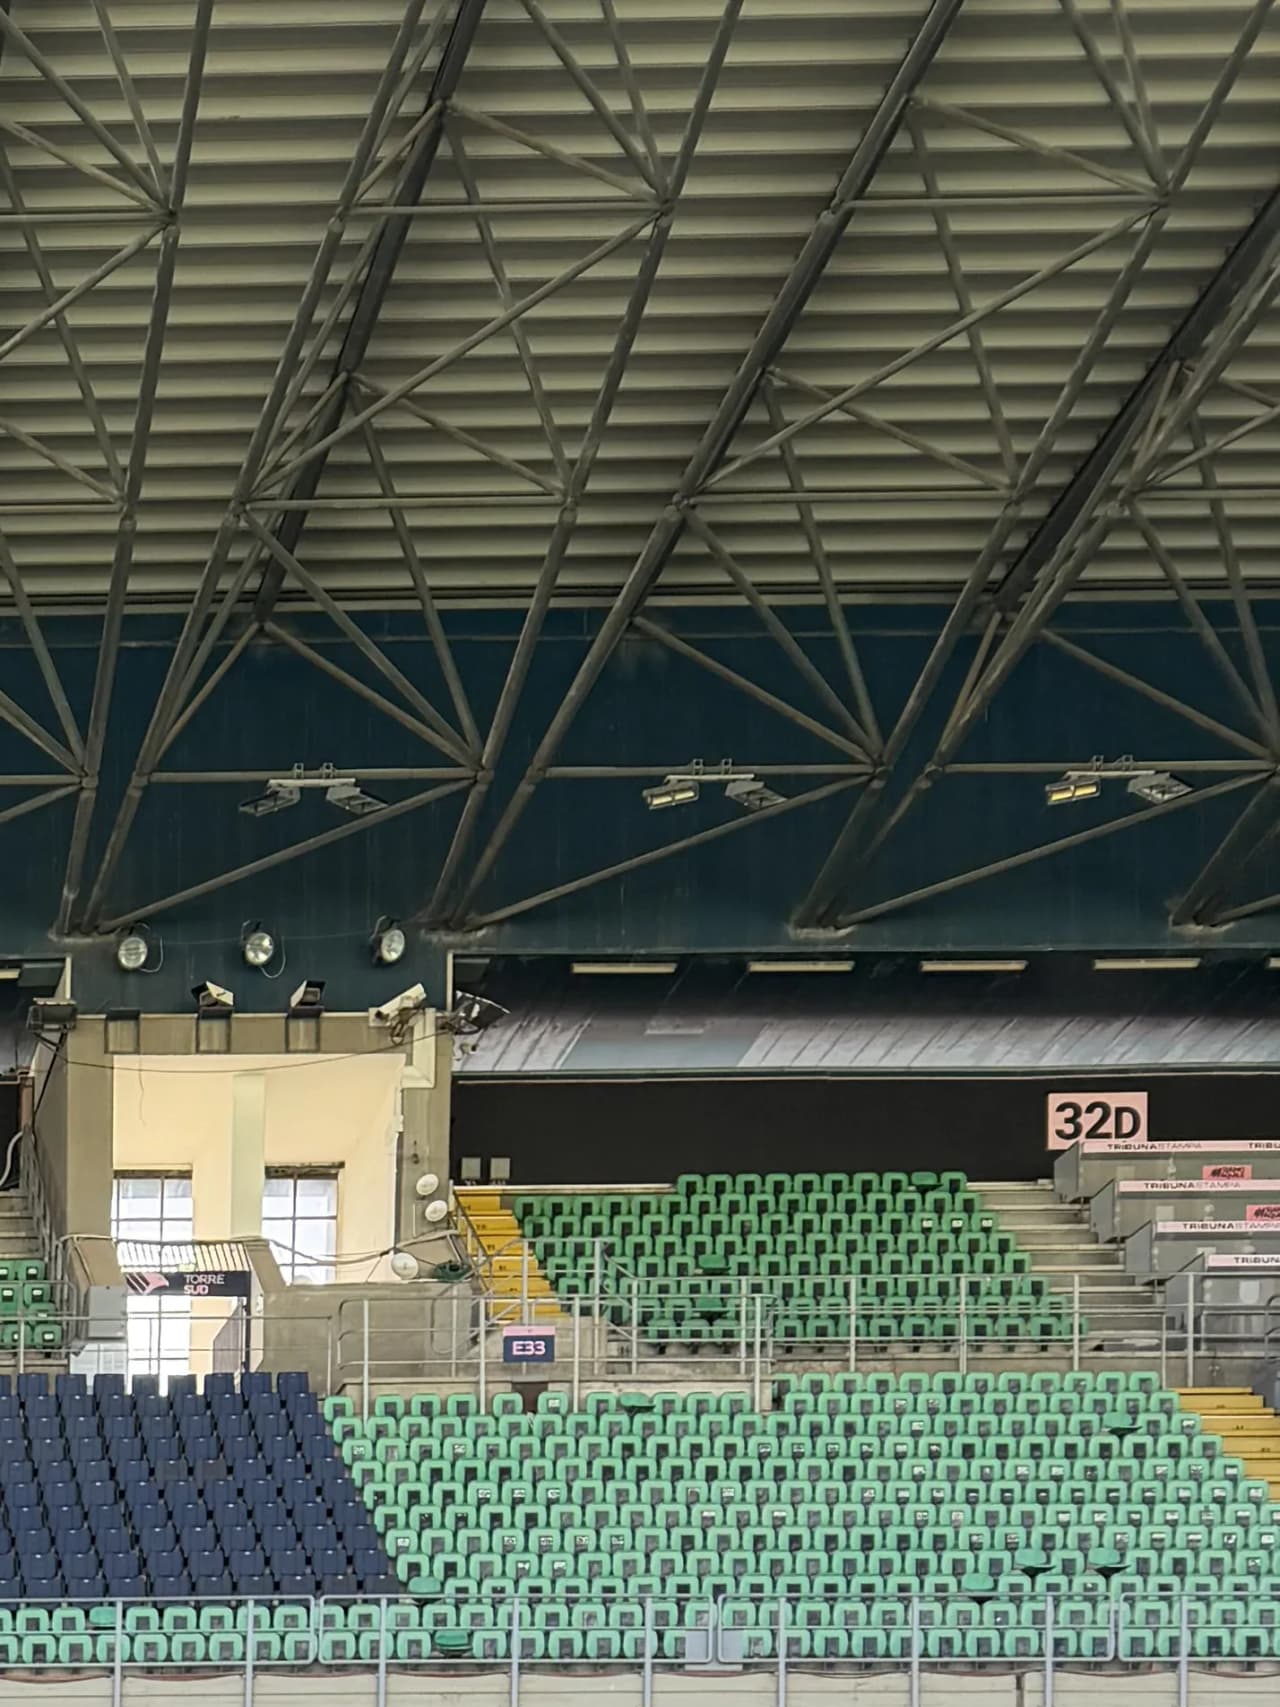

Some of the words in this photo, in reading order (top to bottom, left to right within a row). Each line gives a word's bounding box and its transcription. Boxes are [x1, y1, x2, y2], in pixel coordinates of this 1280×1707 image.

[1054, 1101, 1141, 1140] 32D
[183, 1274, 225, 1285] TORRE
[183, 1284, 209, 1295] SUD
[512, 1341, 546, 1356] E33
